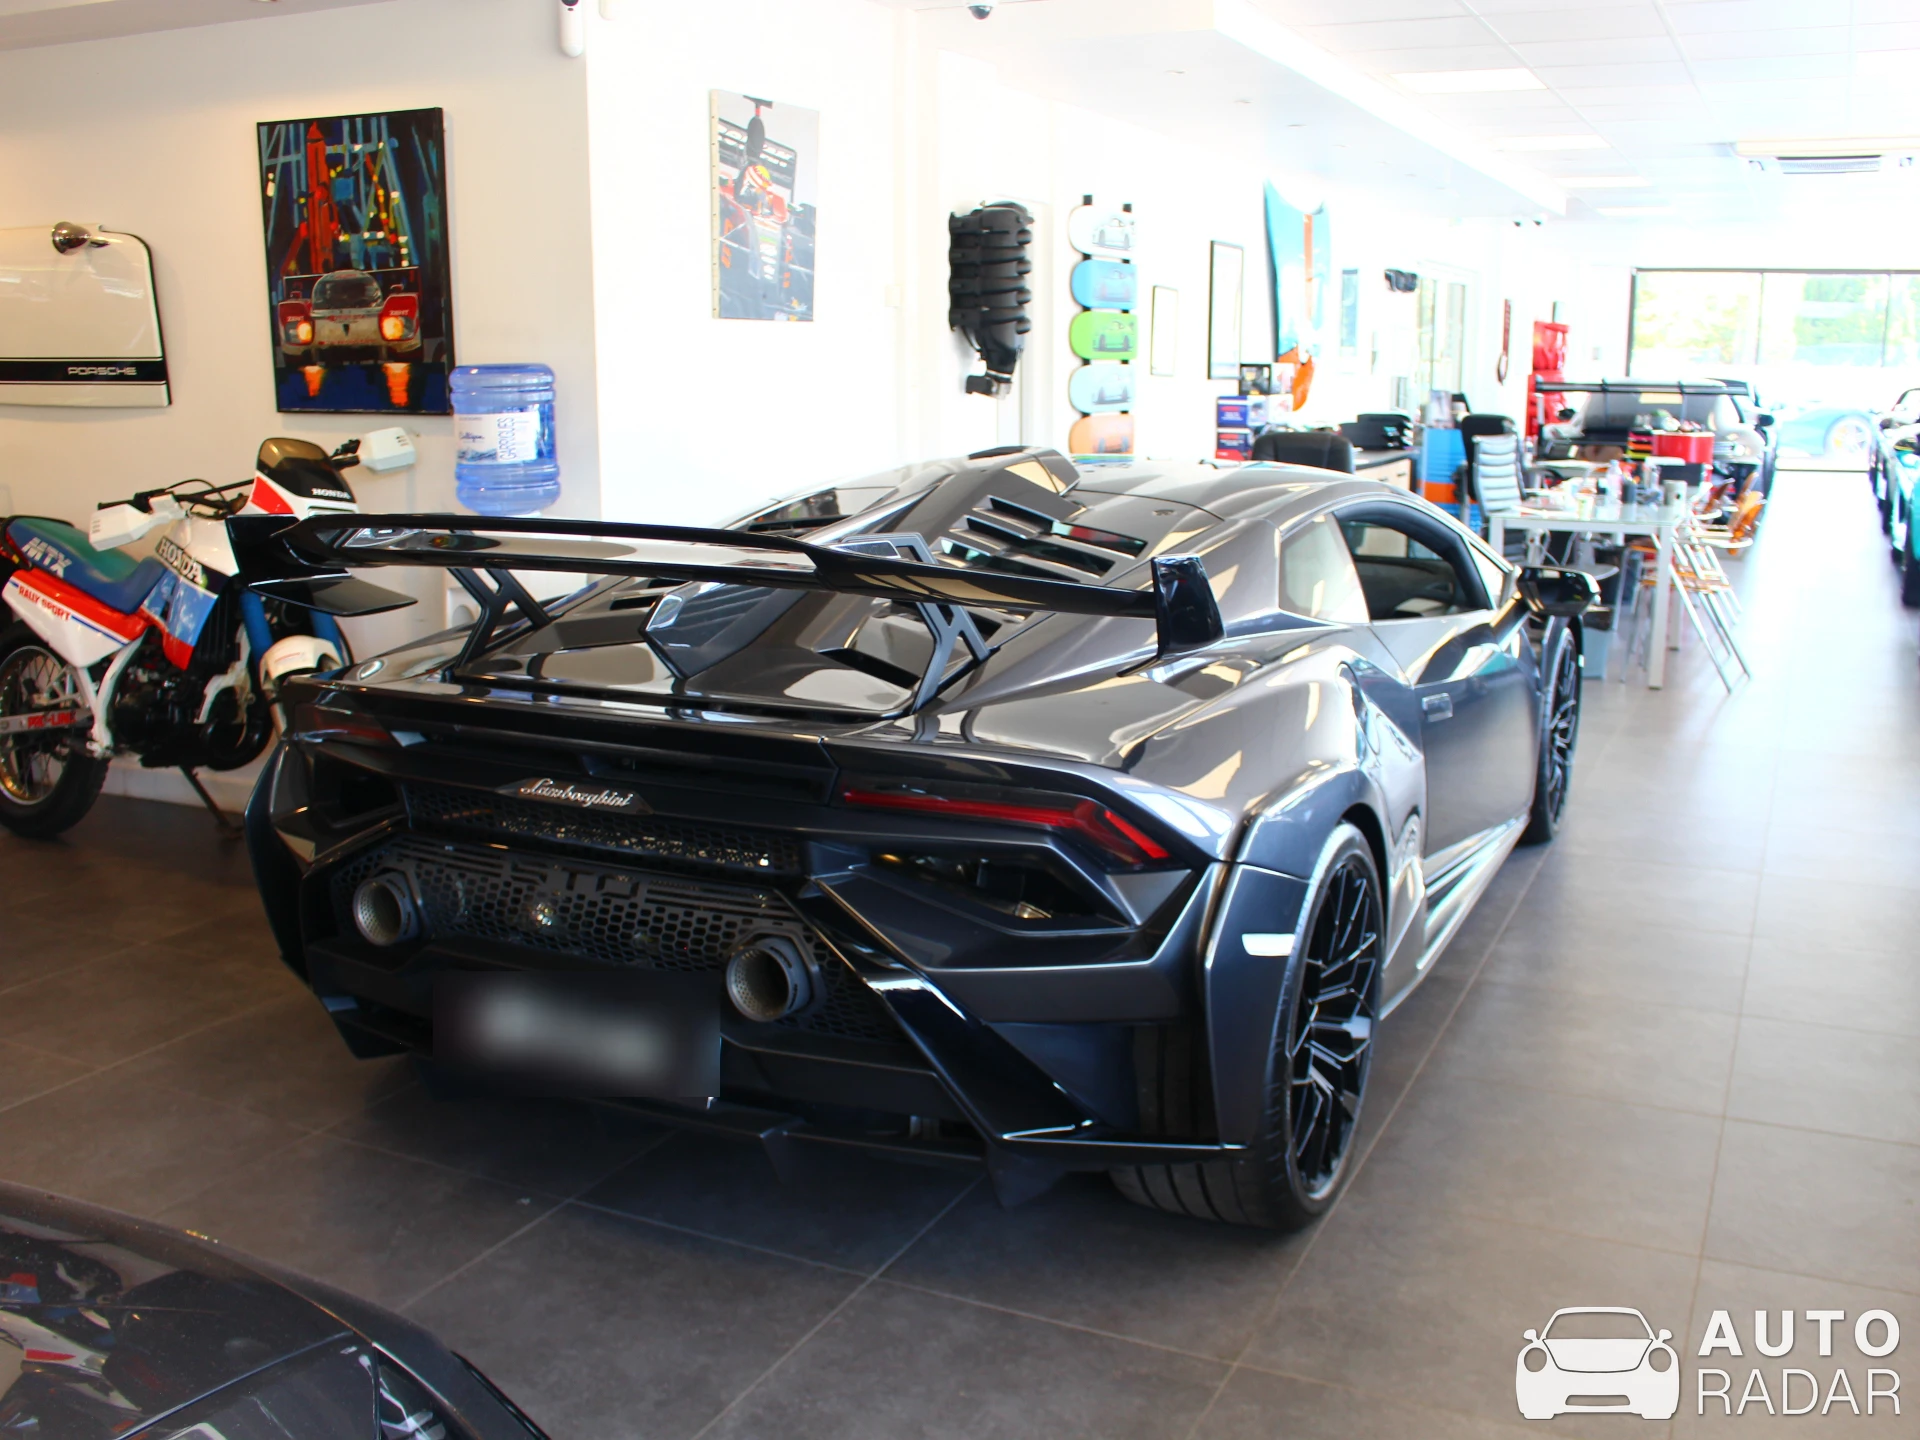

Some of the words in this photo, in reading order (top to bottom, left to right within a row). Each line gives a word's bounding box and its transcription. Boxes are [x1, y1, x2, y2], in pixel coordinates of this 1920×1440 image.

[67, 366, 138, 376] PORSCHE
[312, 488, 352, 500] HONDA
[21, 536, 72, 578] MTX
[158, 538, 205, 585] HONDA
[18, 584, 41, 608] RALLY
[41, 596, 72, 621] SPORT
[520, 778, 634, 808] Lamborghini
